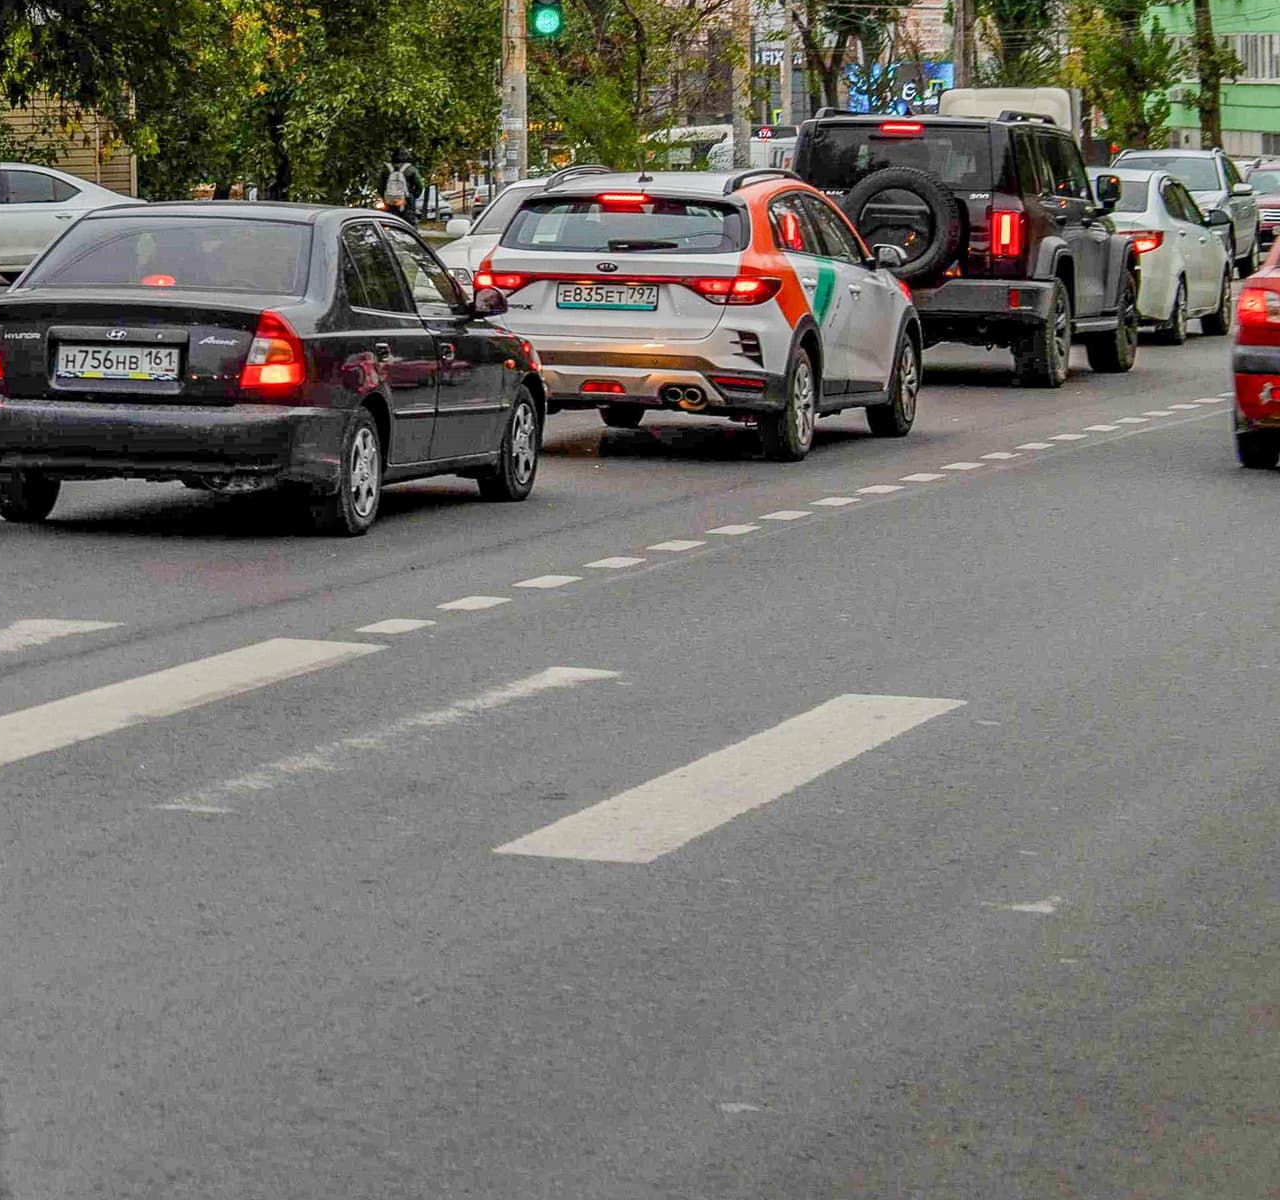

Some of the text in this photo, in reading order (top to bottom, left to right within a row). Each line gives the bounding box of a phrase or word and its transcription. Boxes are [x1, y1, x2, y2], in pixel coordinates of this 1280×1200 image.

[563, 287, 653, 303] Е835ЕТ 797
[65, 349, 173, 370] Н756НВ 161
